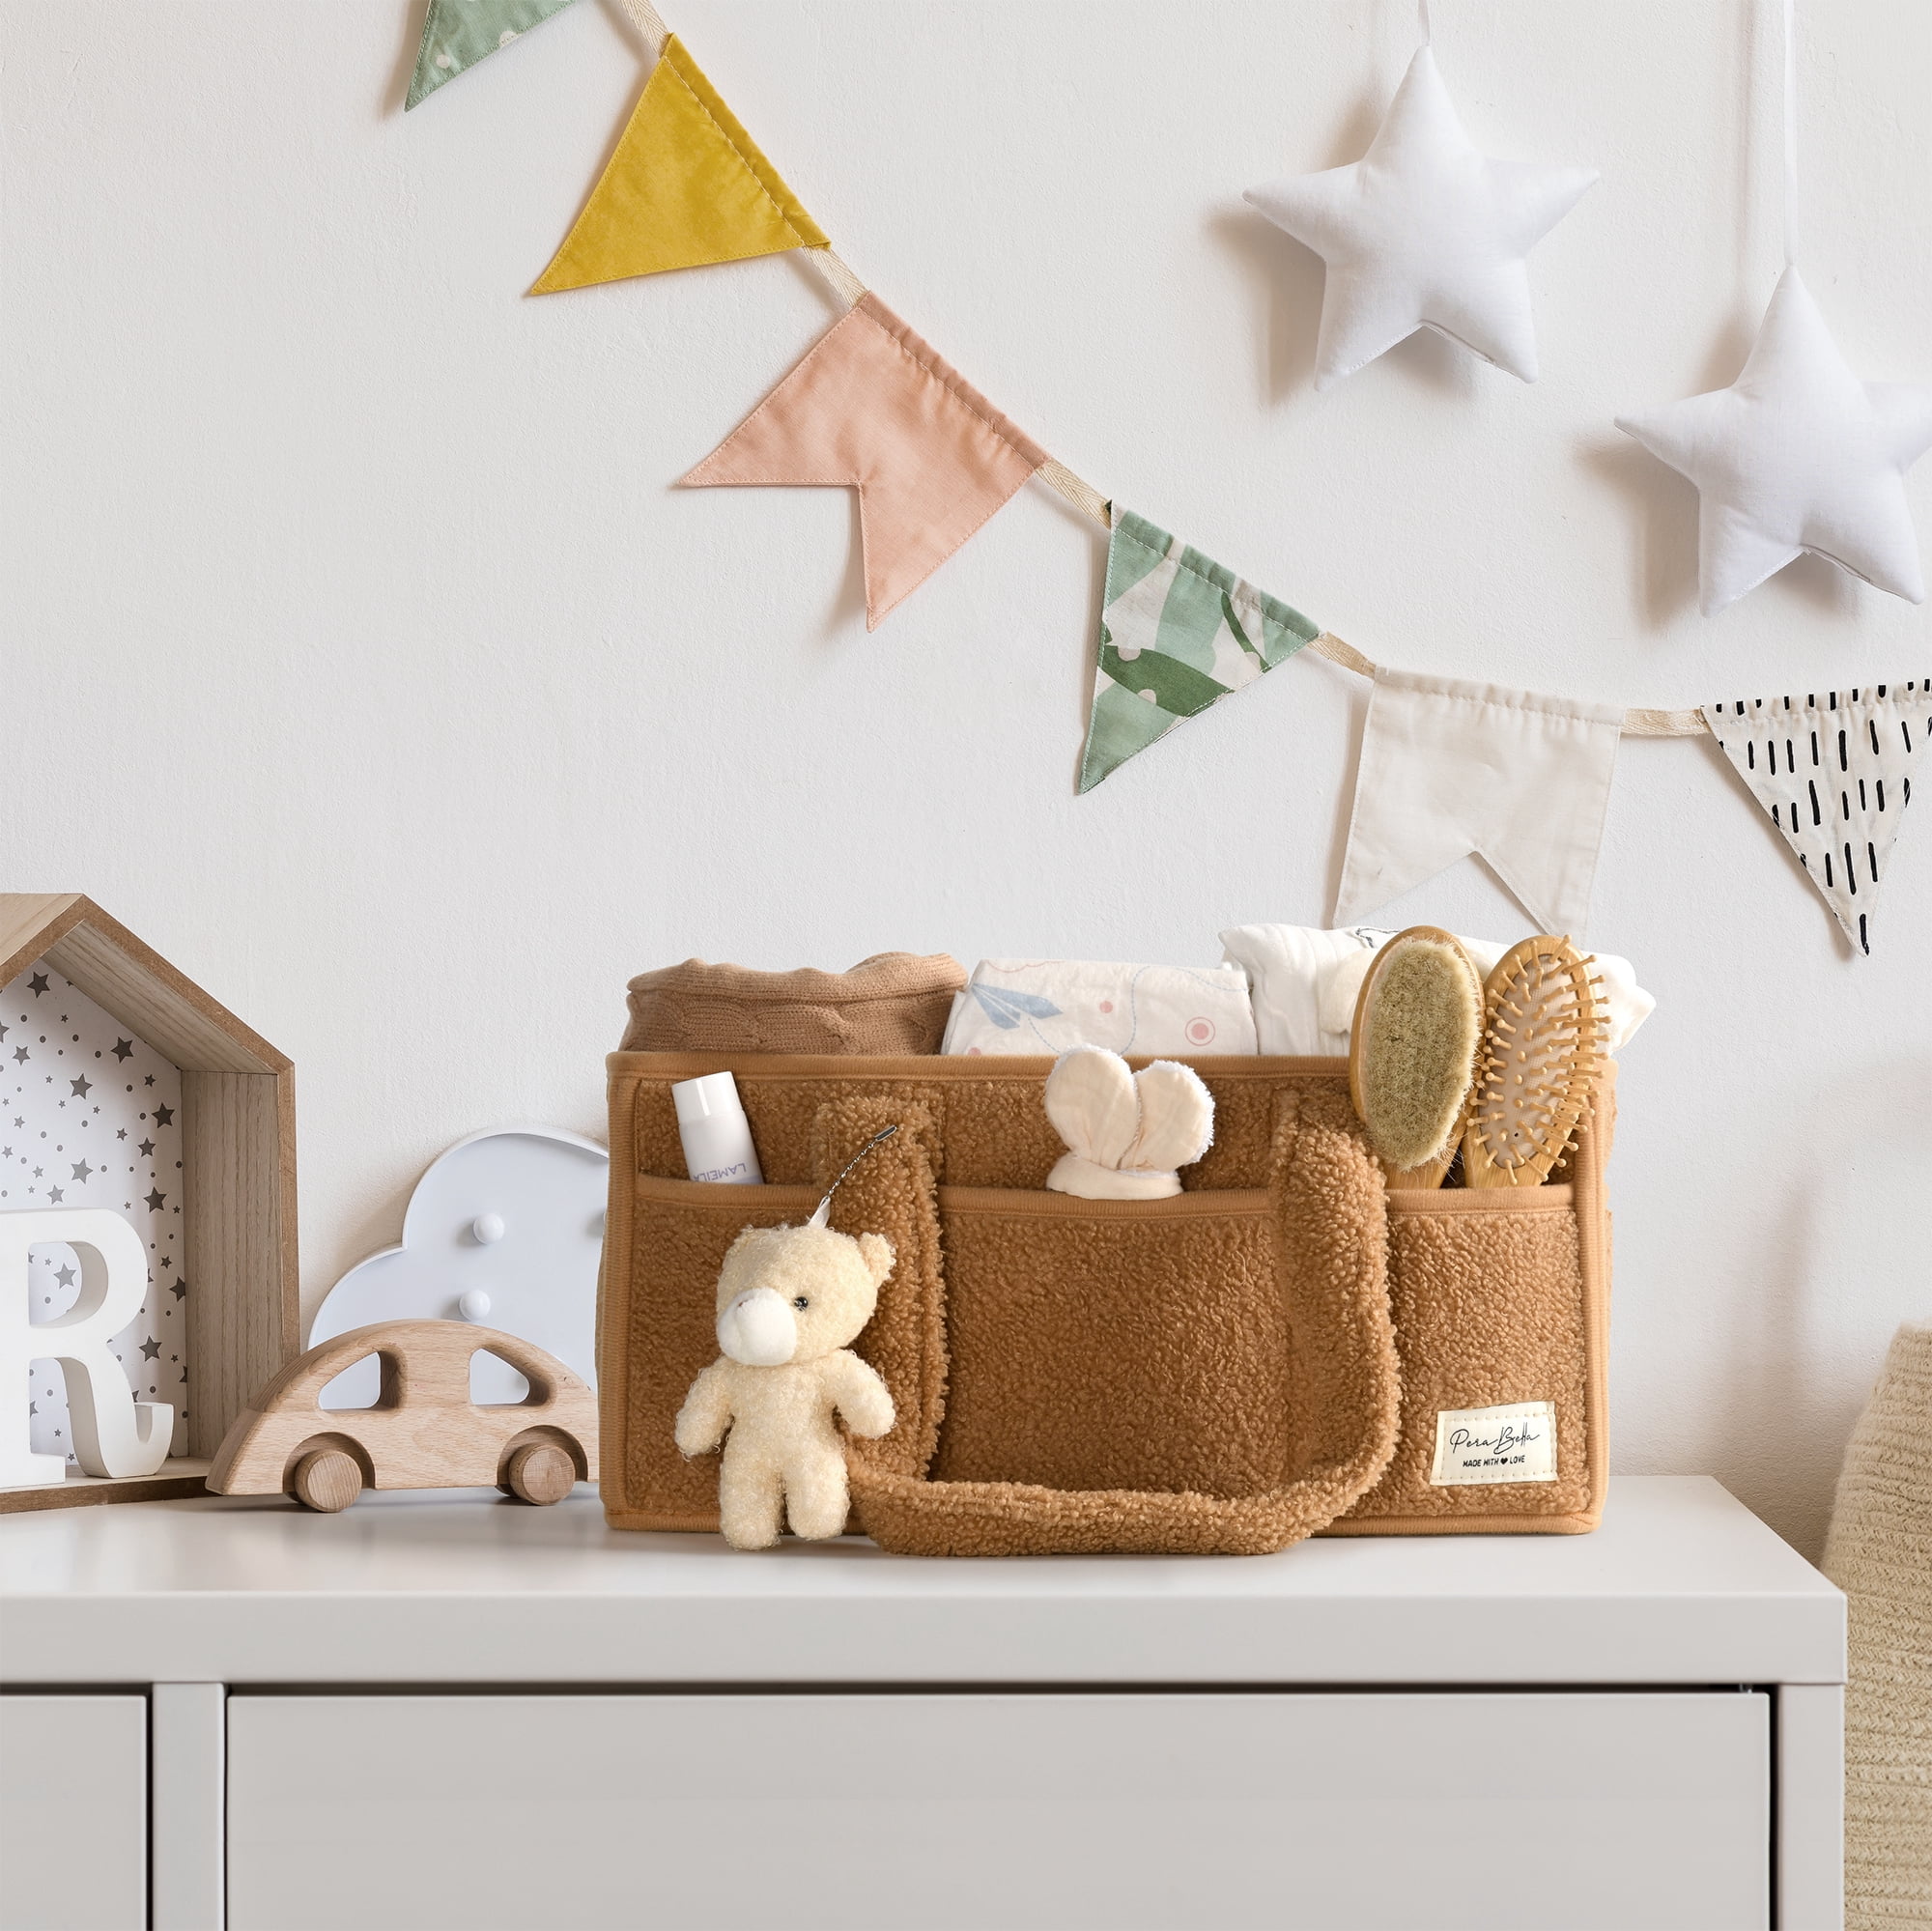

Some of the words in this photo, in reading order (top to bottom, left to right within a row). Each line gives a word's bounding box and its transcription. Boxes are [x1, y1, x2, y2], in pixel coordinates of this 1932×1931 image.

[693, 1162, 746, 1182] LAMEILA
[0, 1207, 175, 1486] R
[1449, 1428, 1498, 1454] Pera
[1493, 1422, 1541, 1455] Bella
[1463, 1459, 1482, 1467] MADE
[1483, 1458, 1499, 1466] WITH
[1509, 1455, 1525, 1464] LOVE
